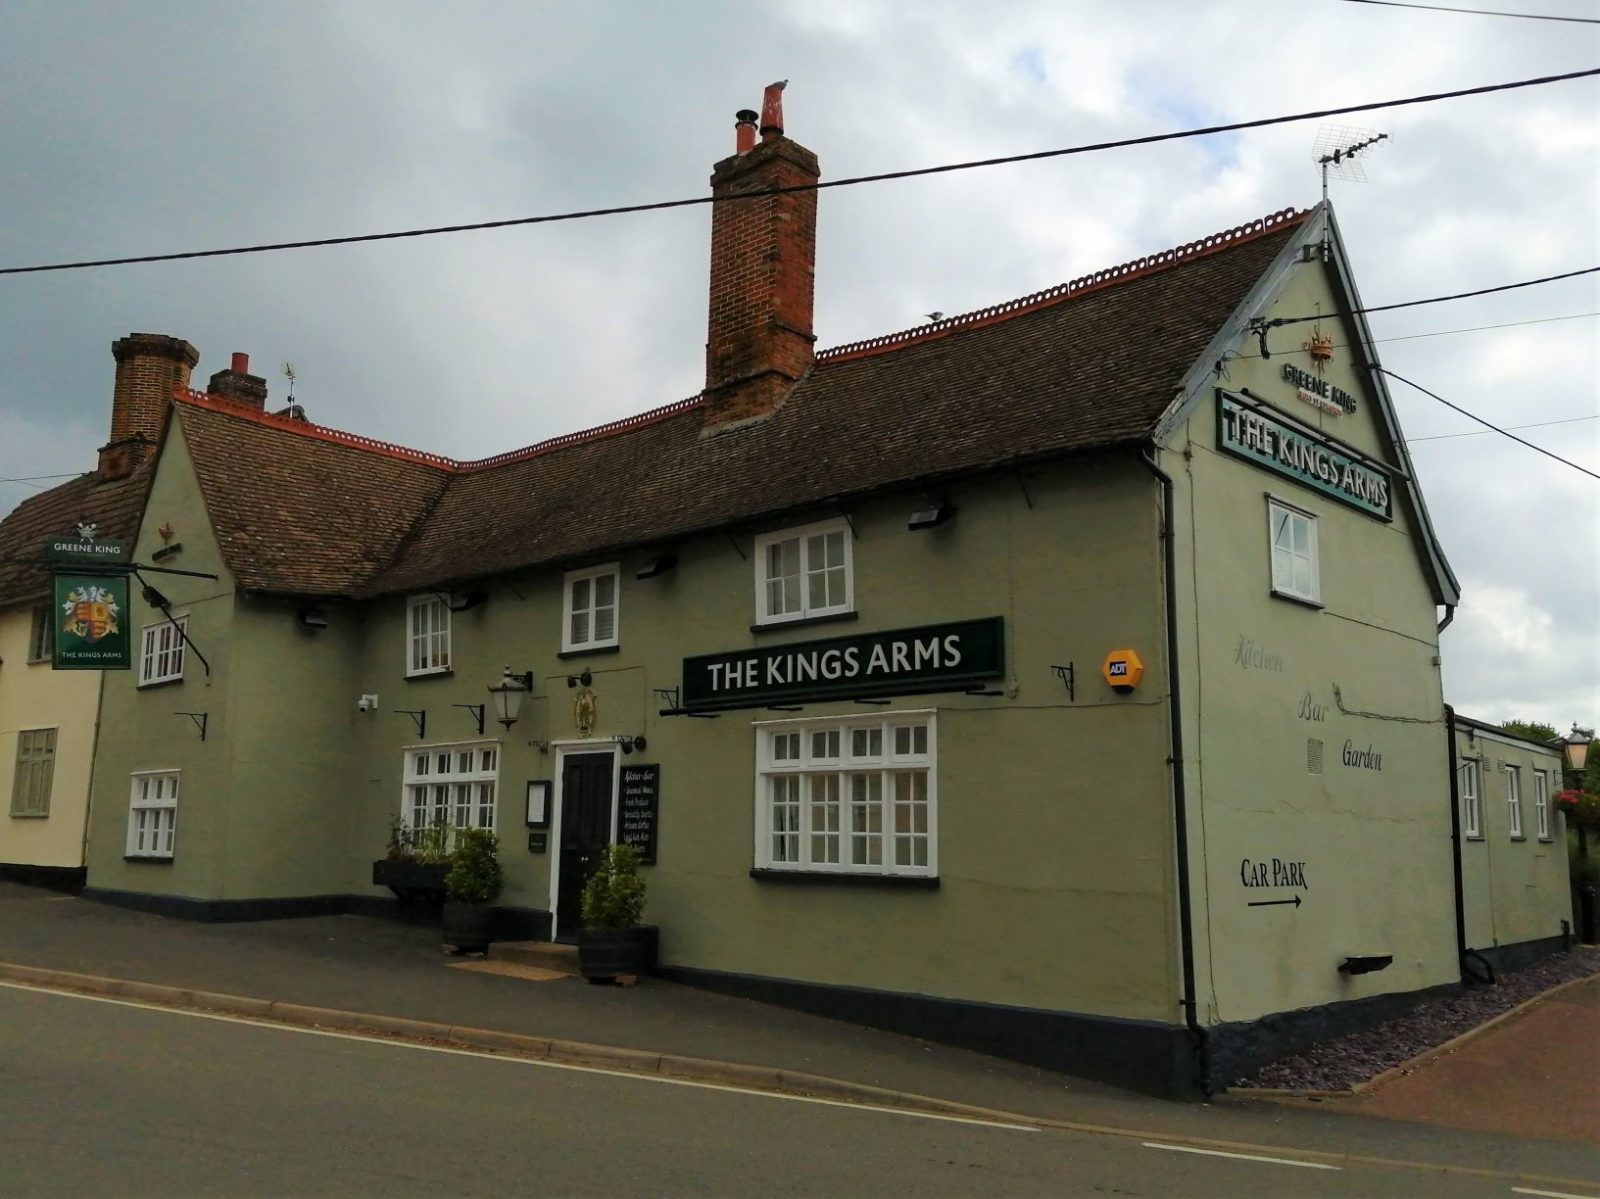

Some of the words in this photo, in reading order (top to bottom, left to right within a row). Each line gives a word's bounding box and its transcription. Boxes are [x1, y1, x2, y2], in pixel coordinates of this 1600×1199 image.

[1281, 363, 1330, 400] GREENE
[1331, 386, 1357, 414] KING
[1227, 406, 1274, 456] THE
[1279, 431, 1339, 484] KINGS
[1342, 461, 1388, 507] ARMS
[53, 542, 92, 553] GREENE
[95, 544, 121, 554] KING
[707, 658, 760, 691] THE
[766, 647, 860, 686] KINGS
[866, 634, 961, 676] ARMS
[1110, 663, 1125, 674] ADT
[1298, 691, 1329, 722] Bar
[1343, 738, 1383, 771] Garden
[1240, 858, 1270, 888] CAR
[1271, 858, 1308, 890] PARK
